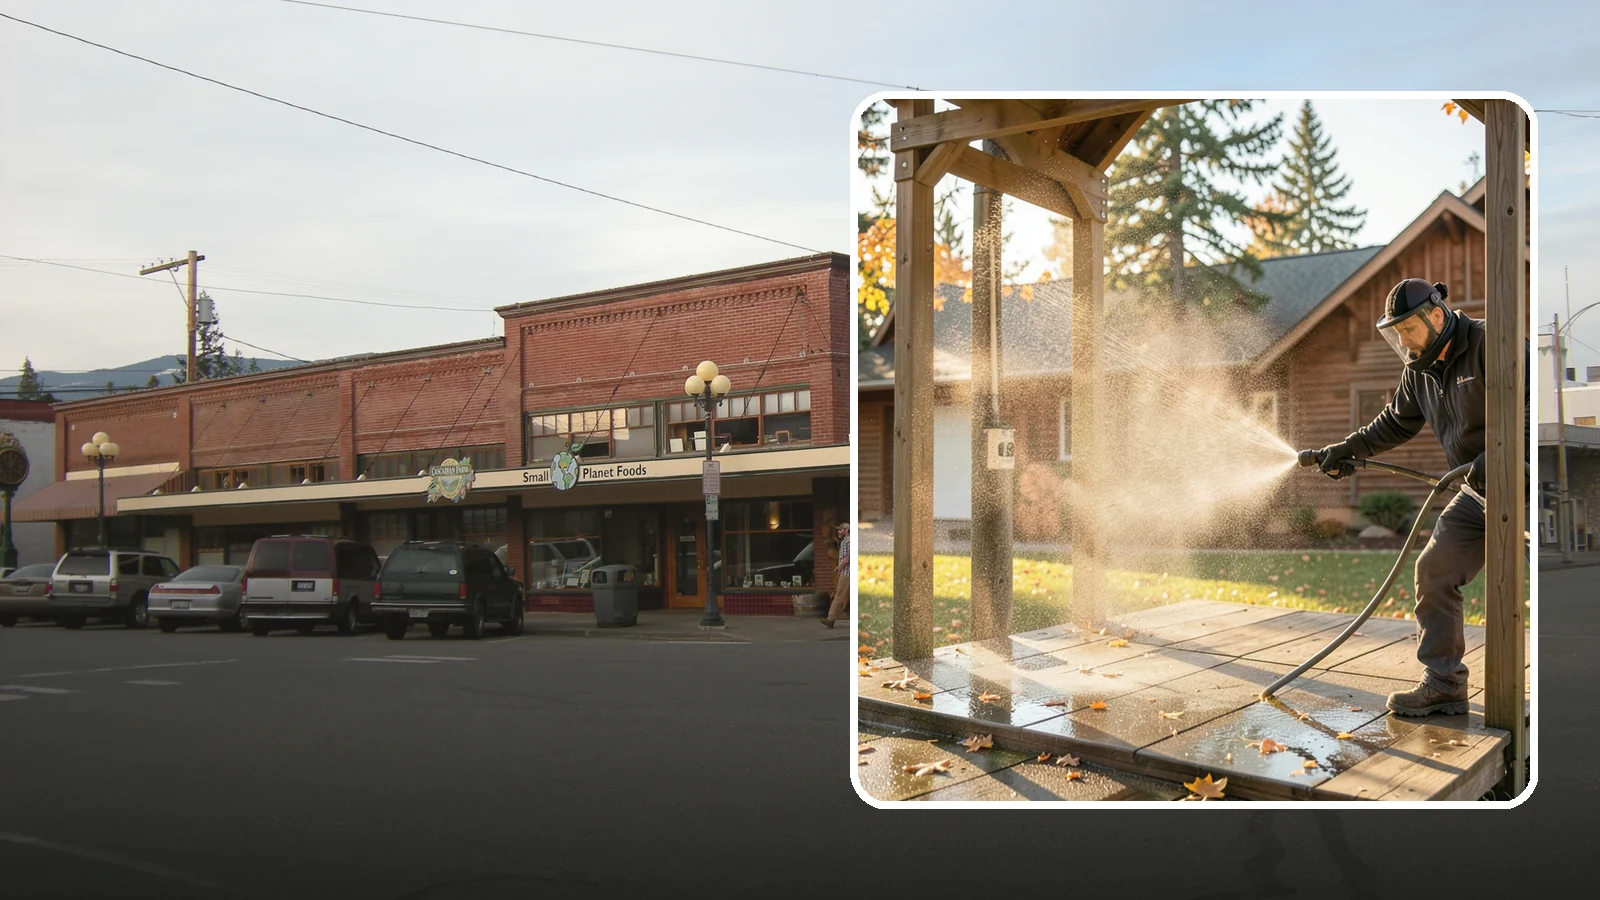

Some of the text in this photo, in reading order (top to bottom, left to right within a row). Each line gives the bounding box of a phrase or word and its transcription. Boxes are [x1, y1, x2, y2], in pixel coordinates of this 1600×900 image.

[523, 464, 647, 483] Small Planet Foods
